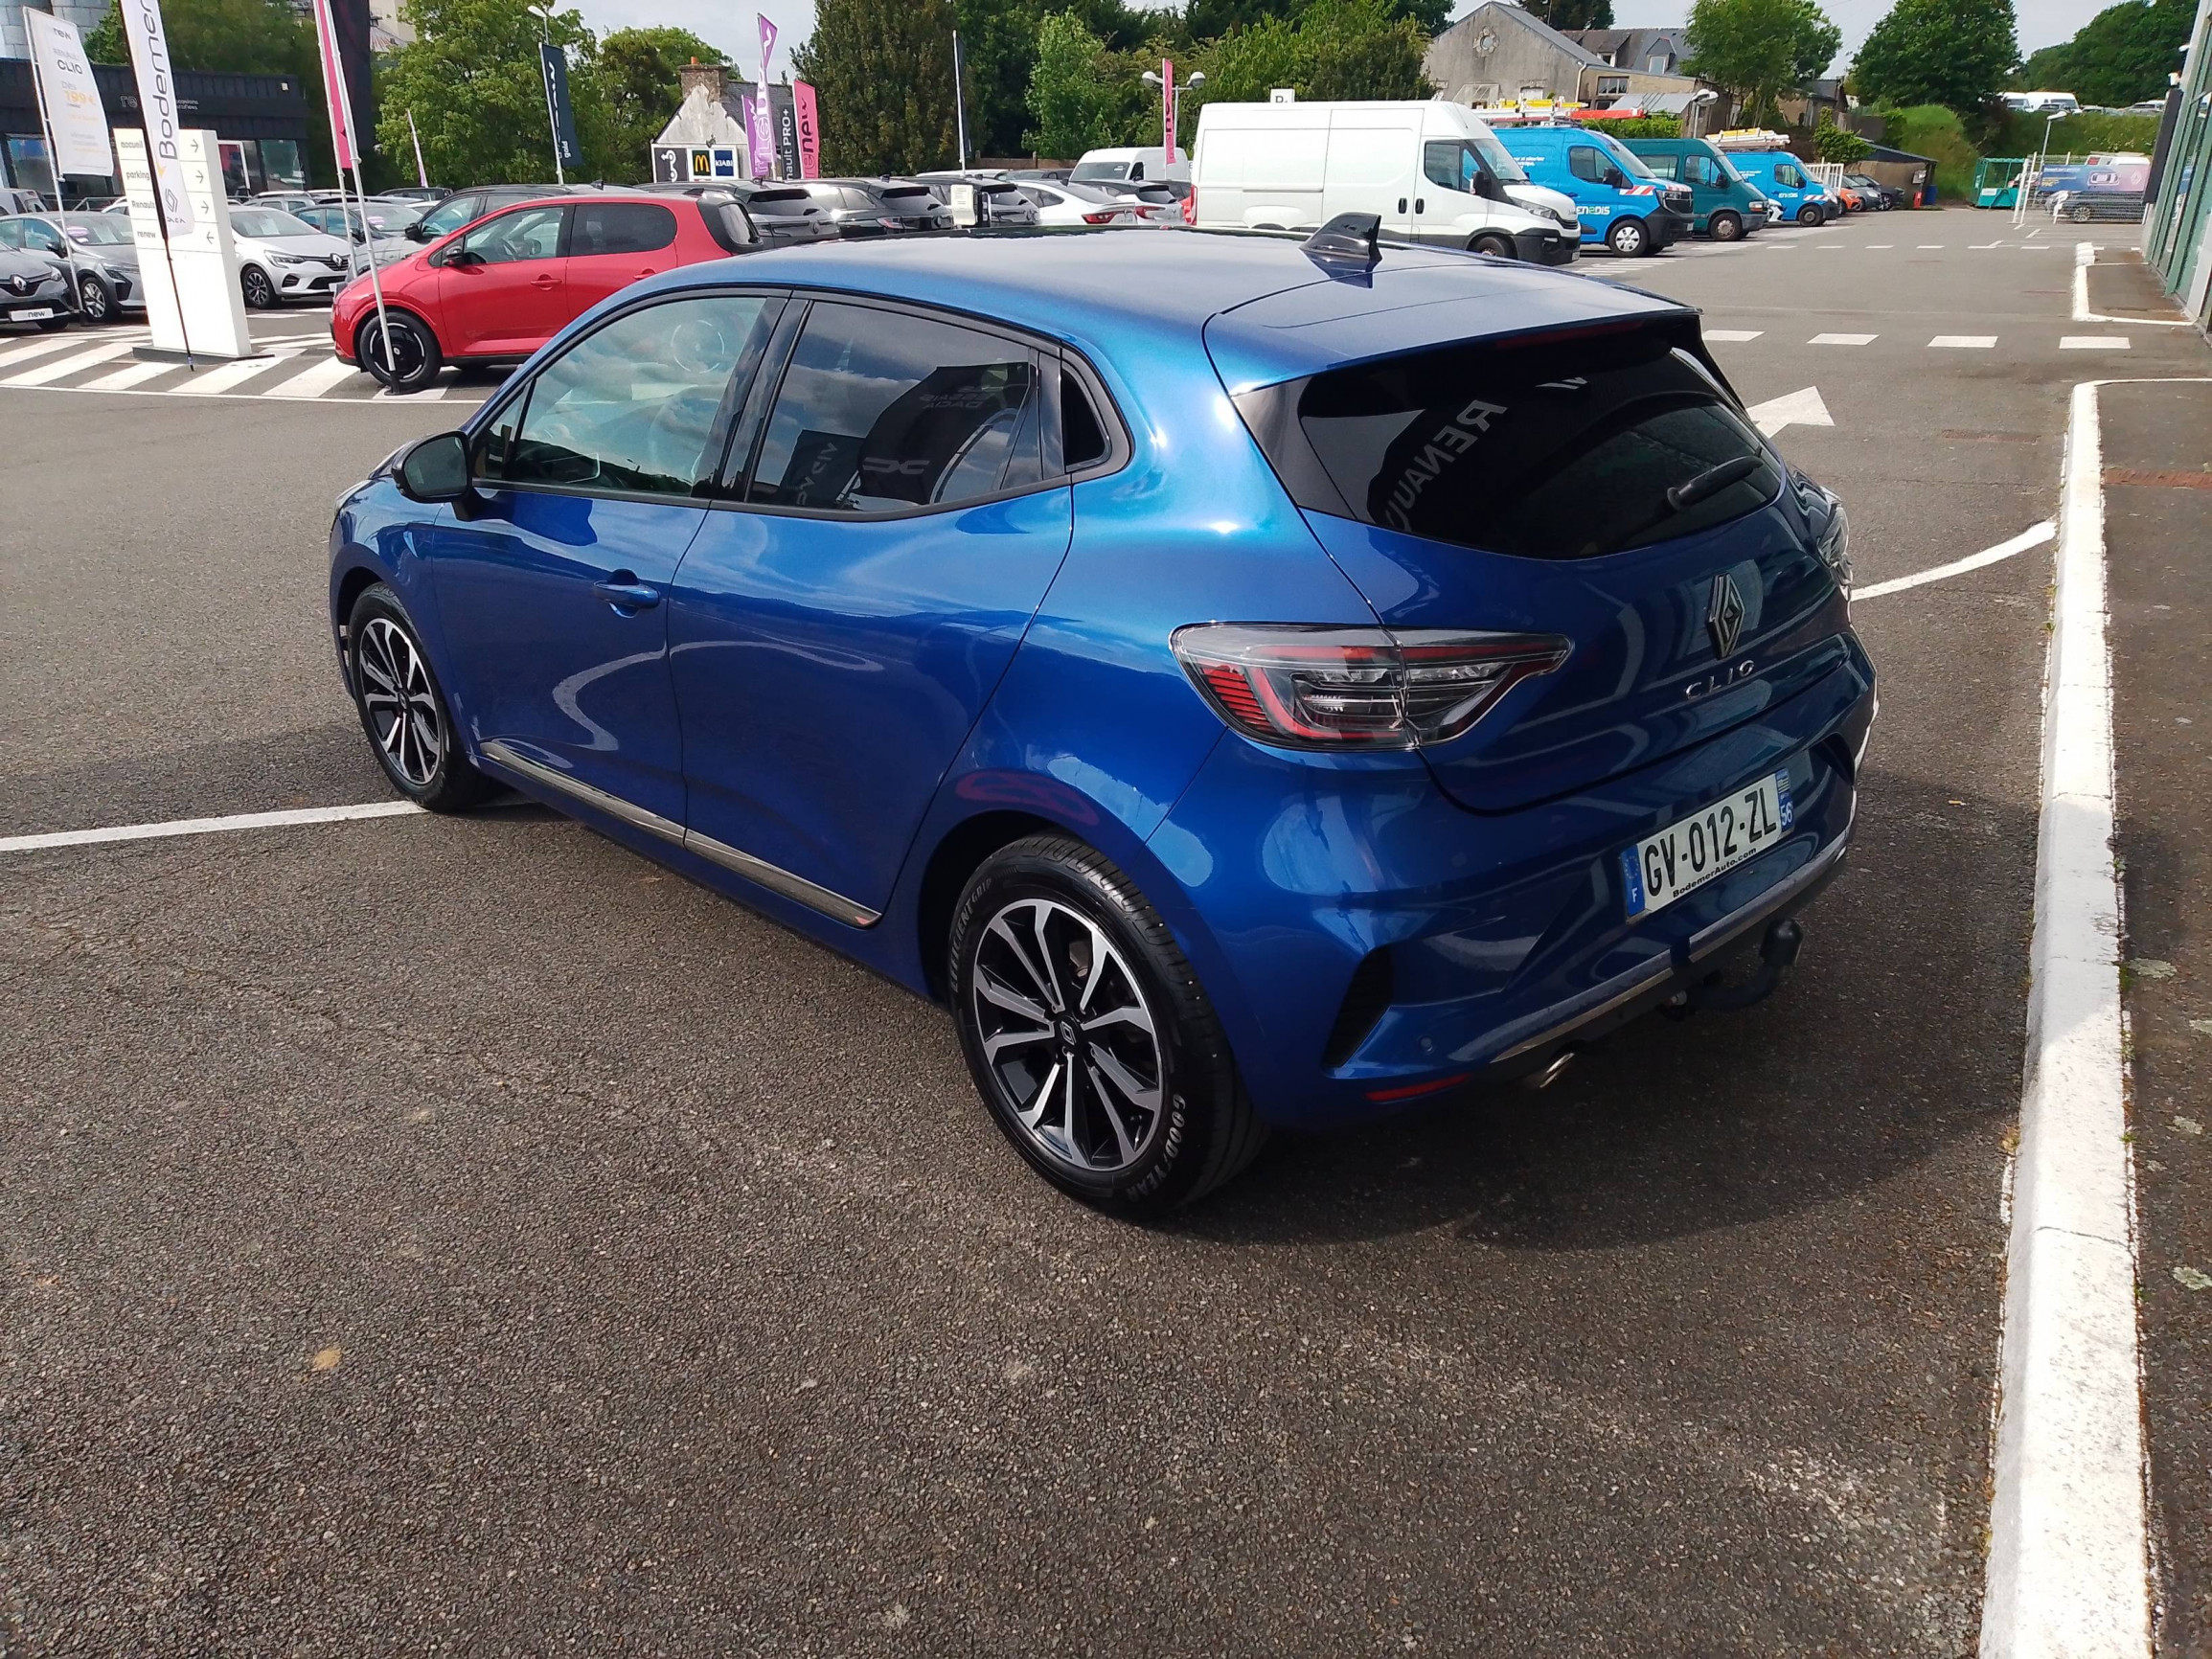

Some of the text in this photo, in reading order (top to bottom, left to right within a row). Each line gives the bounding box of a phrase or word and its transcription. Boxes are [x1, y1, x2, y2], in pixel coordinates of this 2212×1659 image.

[57, 58, 83, 75] CLIO
[561, 140, 572, 159] gold
[782, 108, 793, 181] nault PRO+
[126, 170, 150, 180] parking
[131, 200, 155, 209] Renault
[1685, 659, 1755, 700] CLIO
[1780, 801, 1793, 827] 56
[1644, 786, 1777, 898] GV-012-ZL
[1672, 847, 1757, 899] BodemerAuto.com
[1631, 887, 1638, 903] F
